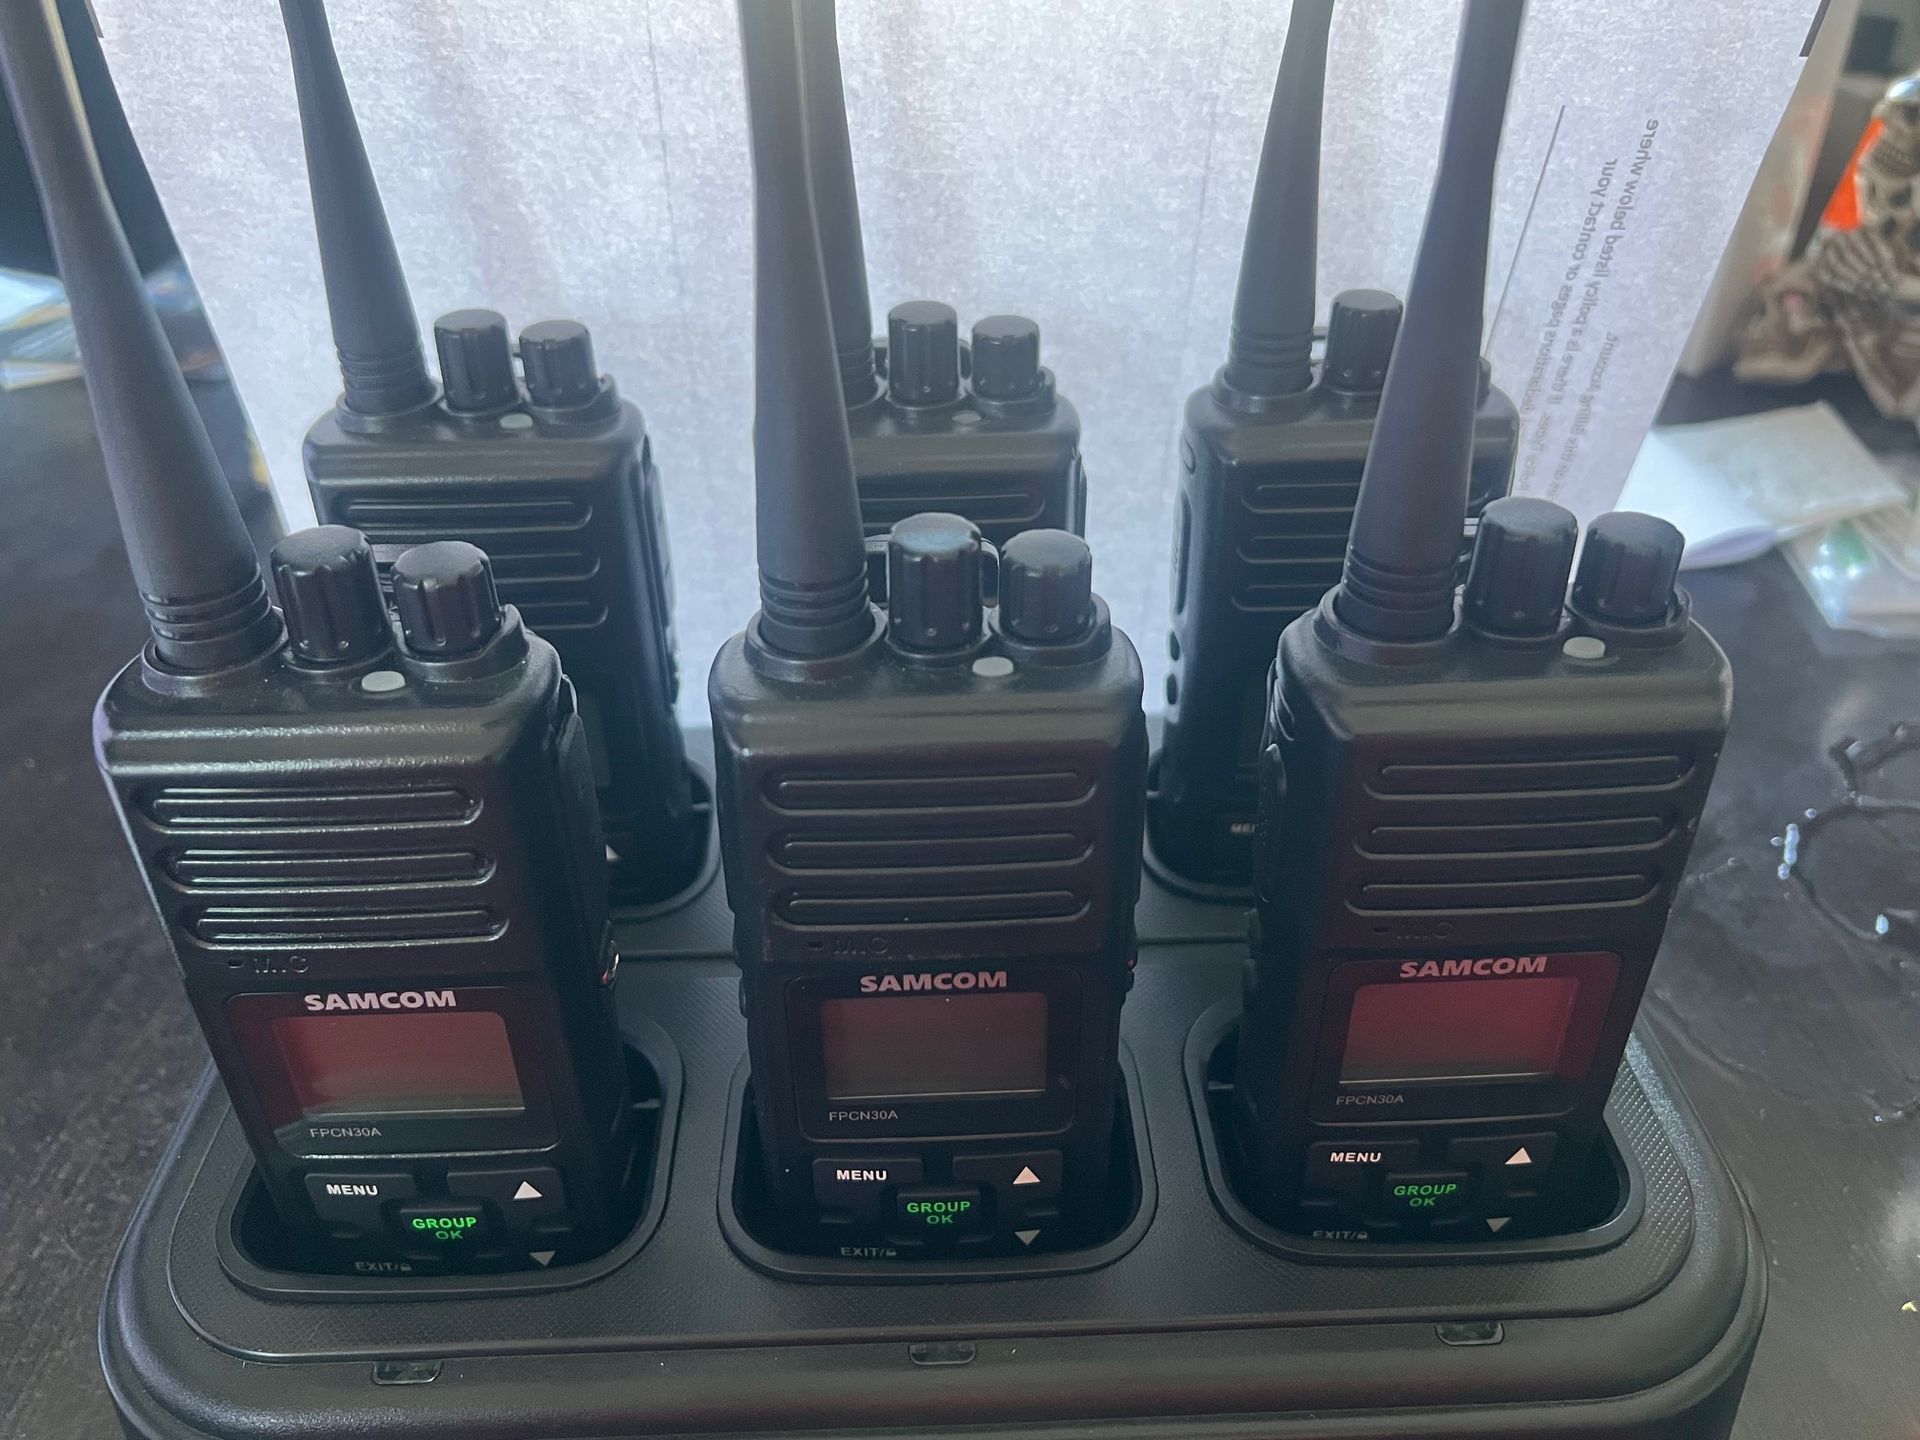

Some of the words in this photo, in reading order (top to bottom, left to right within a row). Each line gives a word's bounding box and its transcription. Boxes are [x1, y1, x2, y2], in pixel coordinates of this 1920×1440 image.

[1399, 956, 1548, 978] SAMCOM
[860, 971, 1007, 993] SAMCOM
[304, 990, 457, 1011] SAMCOM
[1335, 1094, 1404, 1105] FPCN30A
[828, 1110, 899, 1121] FPCN30A
[310, 1127, 382, 1138] FPCN30A
[1329, 1152, 1382, 1163] MENU
[836, 1169, 887, 1180] MENU
[326, 1184, 378, 1196] MENU
[1393, 1184, 1457, 1196] GROUP
[906, 1201, 971, 1213] GROUP
[1409, 1197, 1436, 1207] OK
[412, 1216, 478, 1229] GROUP
[926, 1214, 954, 1225] OK
[435, 1230, 463, 1240] OK
